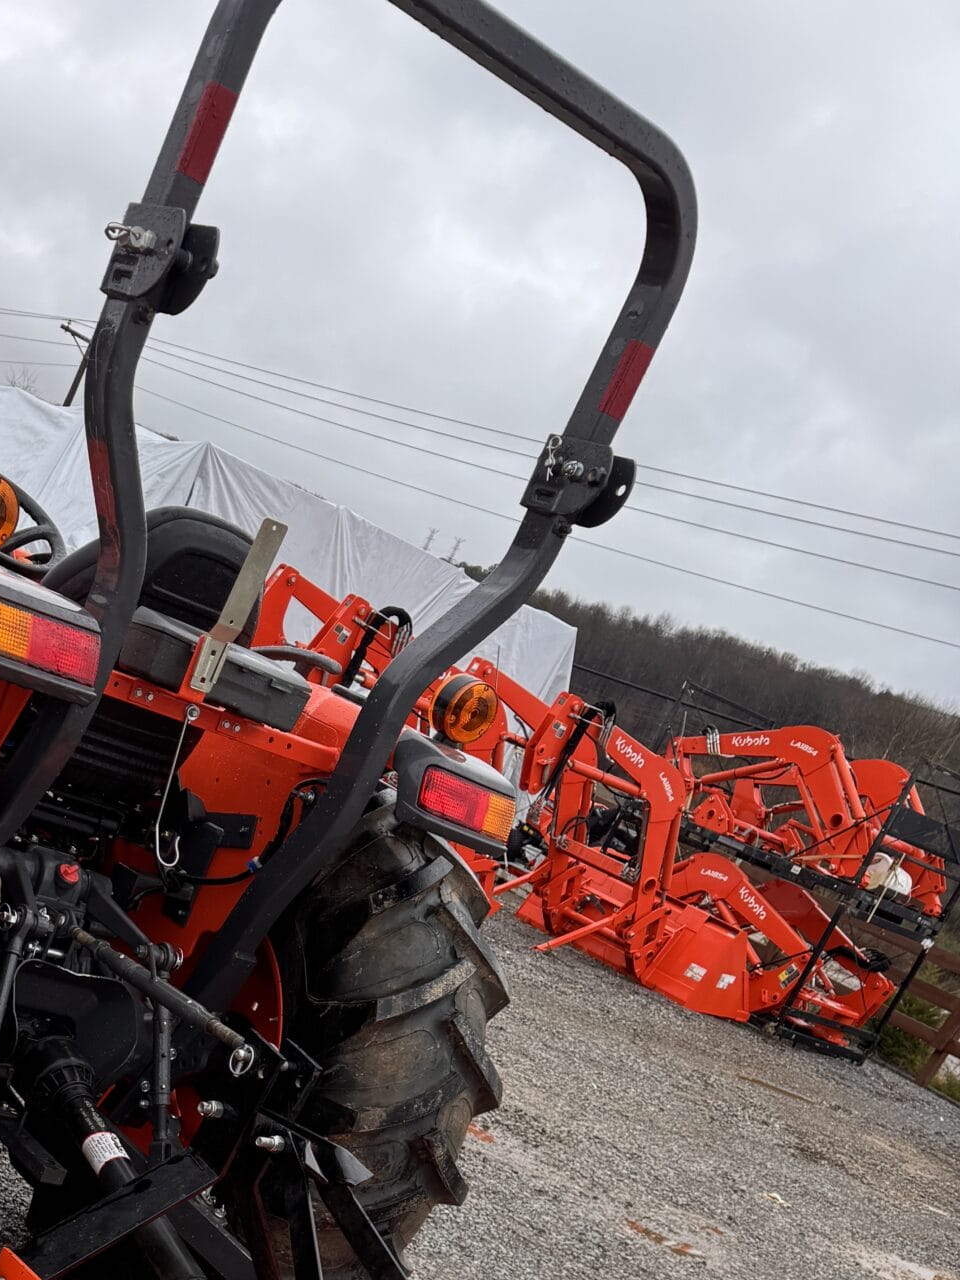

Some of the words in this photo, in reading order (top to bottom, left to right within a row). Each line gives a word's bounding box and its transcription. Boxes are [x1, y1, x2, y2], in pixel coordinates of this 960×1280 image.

[615, 736, 645, 768] Kubota
[731, 734, 770, 747] Kubota
[739, 886, 767, 920] Kubota
